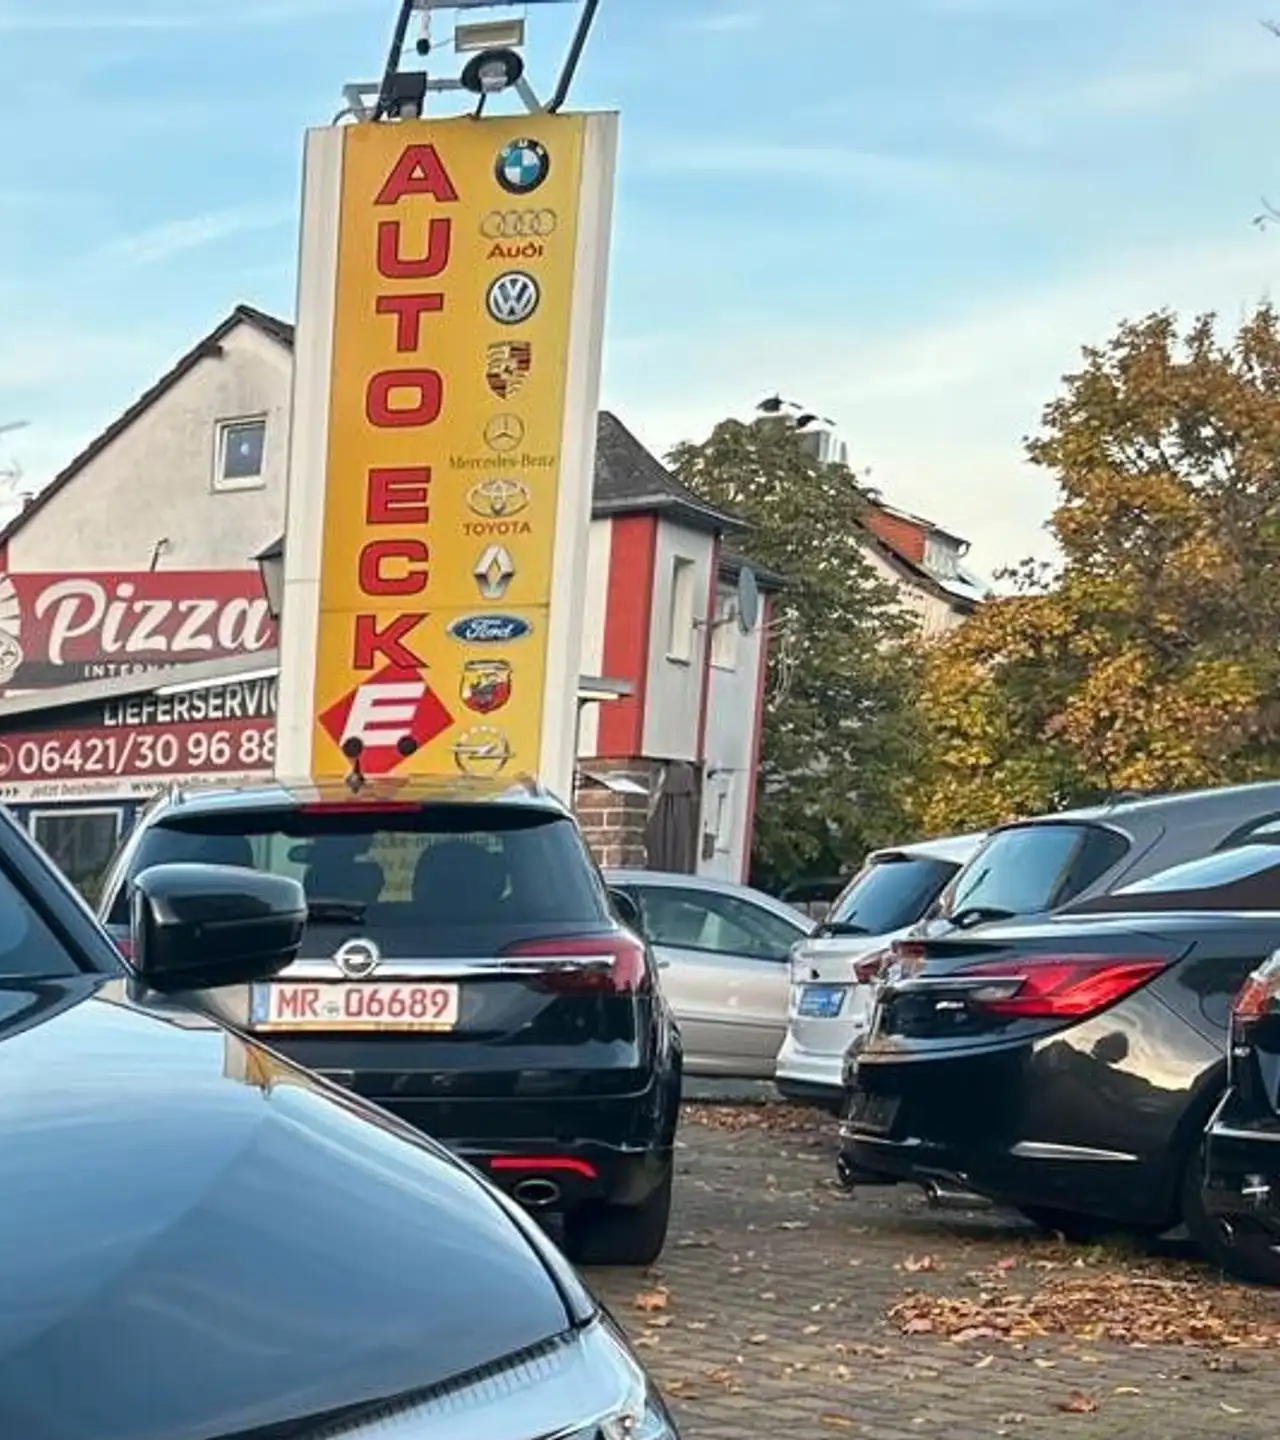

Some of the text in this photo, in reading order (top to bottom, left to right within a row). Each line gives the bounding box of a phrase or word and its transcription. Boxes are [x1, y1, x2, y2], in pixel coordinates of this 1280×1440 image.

[486, 242, 544, 260] Audi
[365, 143, 459, 428] AUTO
[449, 453, 555, 469] Mercedes-Benz
[462, 521, 531, 537] TOYOTA
[34, 578, 271, 666] Pizza
[17, 731, 179, 775] 06421/30
[187, 730, 230, 767] 96
[277, 988, 450, 1018] MR 06689
